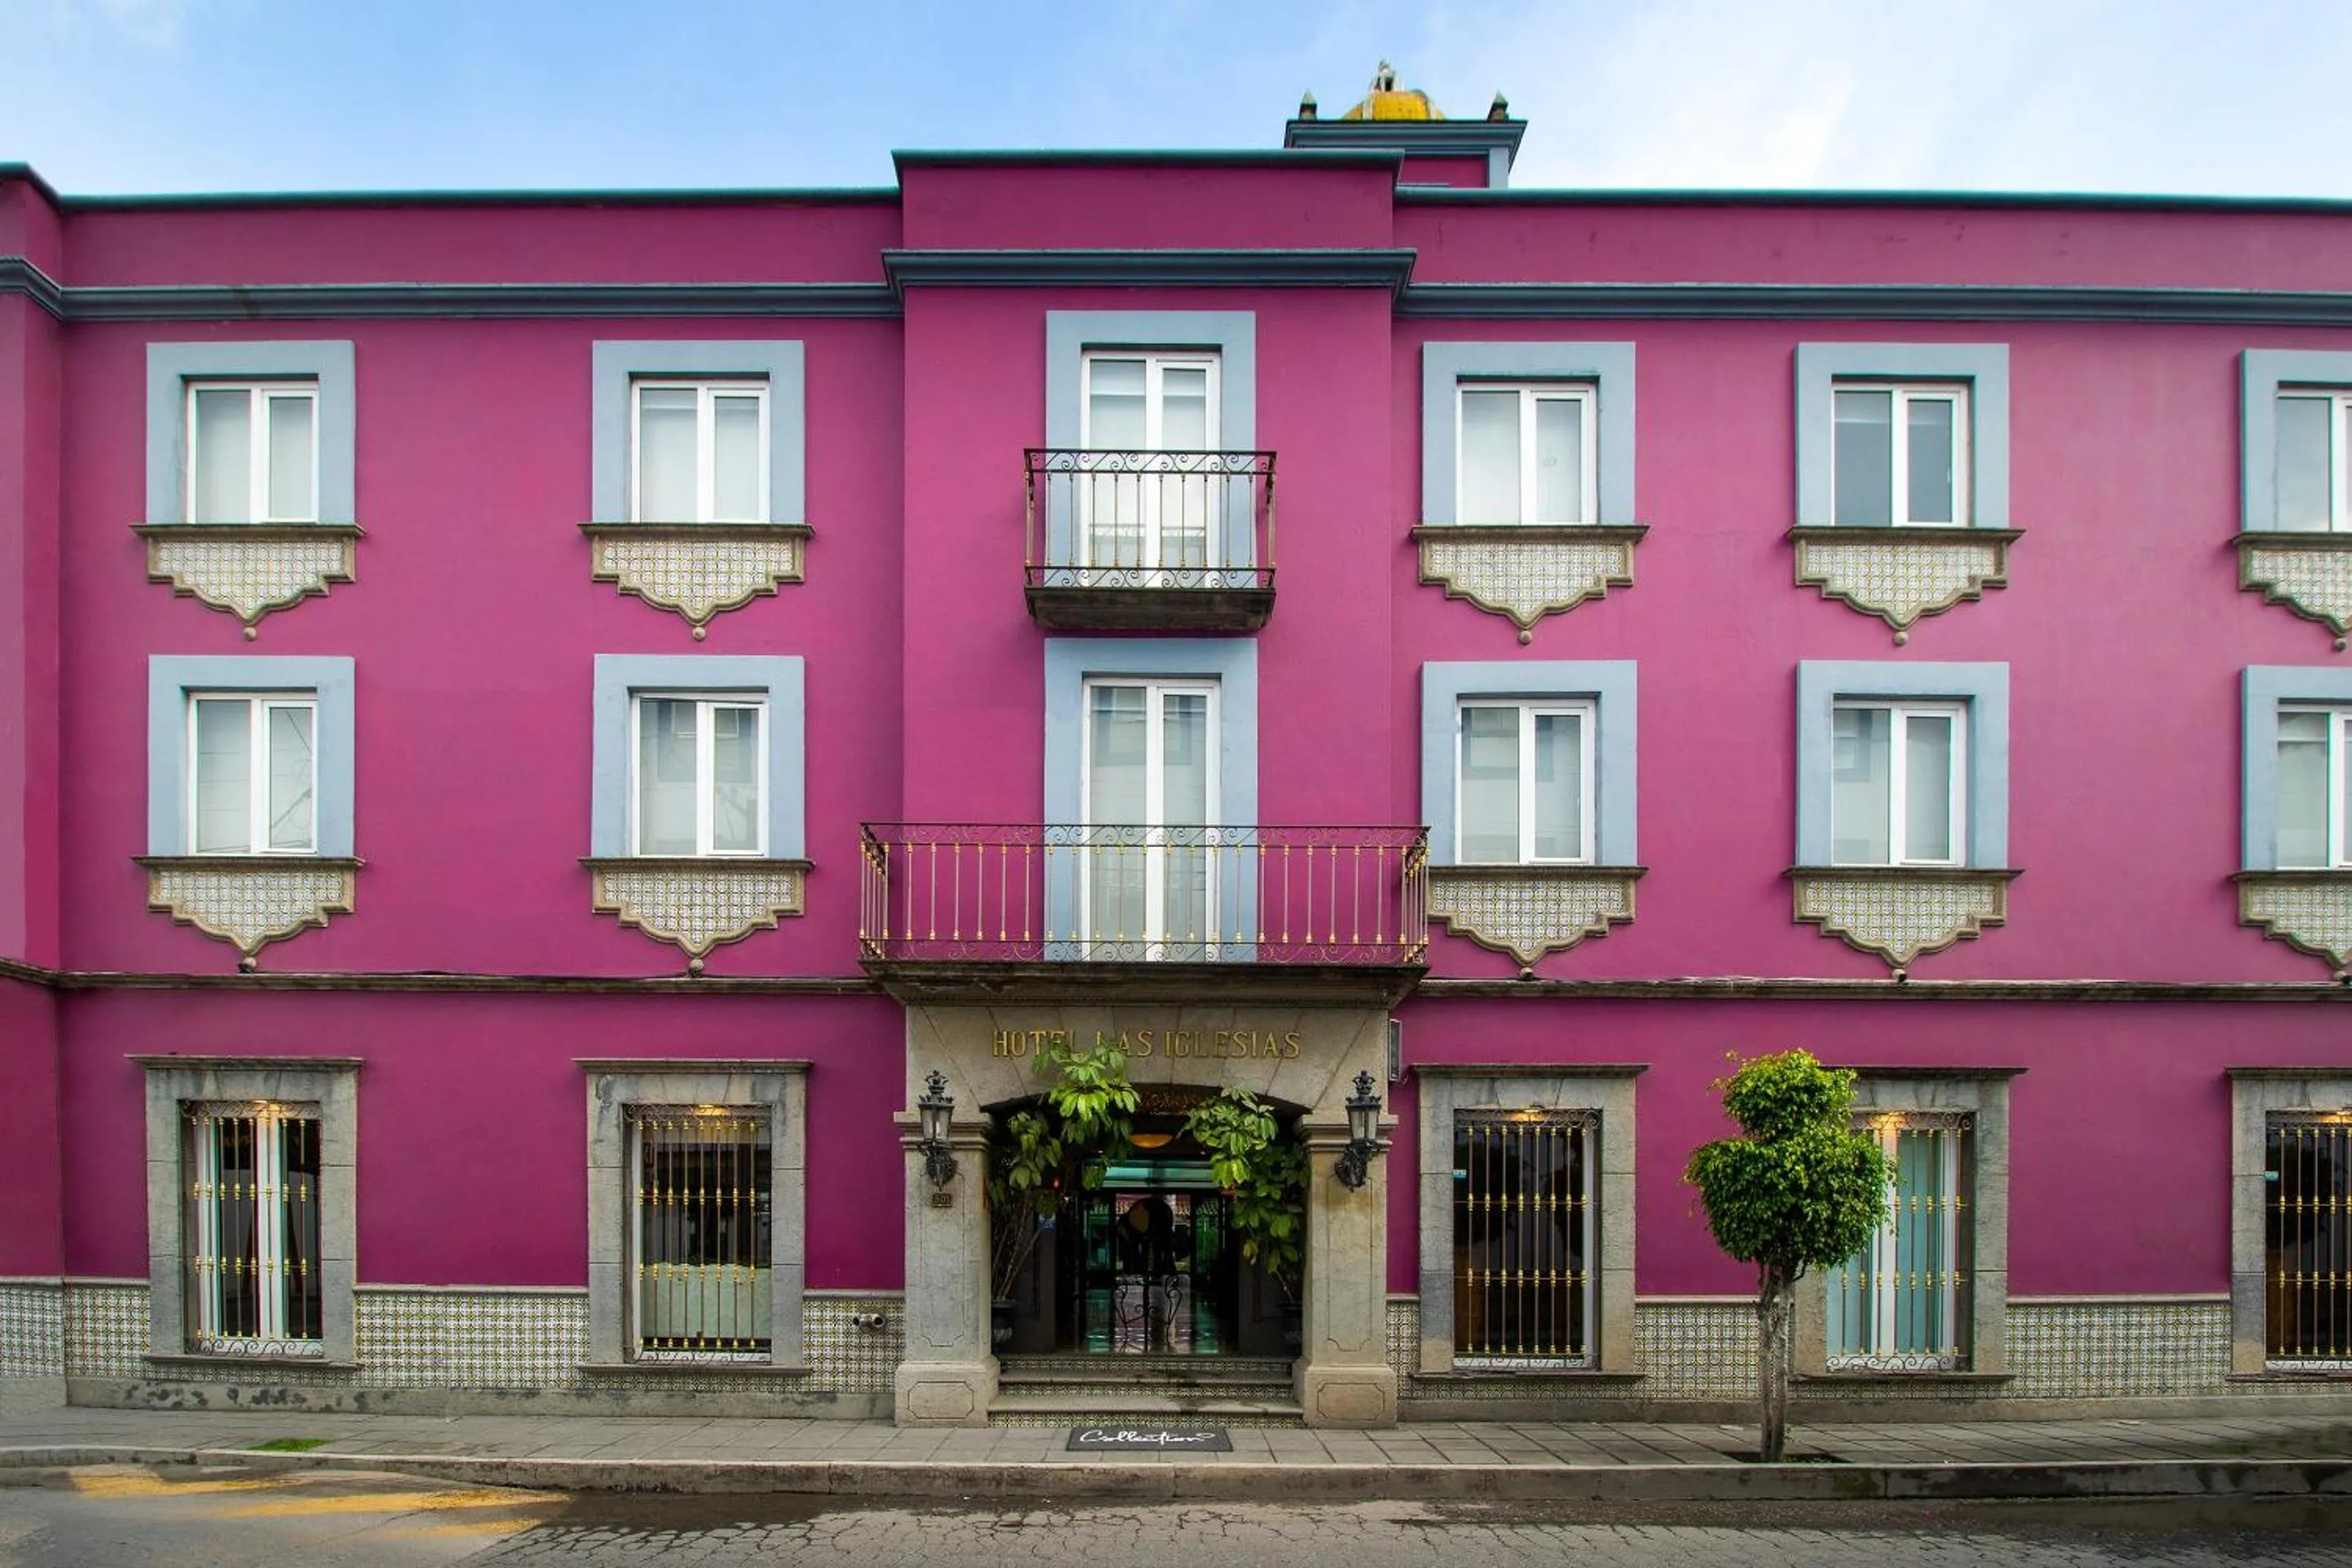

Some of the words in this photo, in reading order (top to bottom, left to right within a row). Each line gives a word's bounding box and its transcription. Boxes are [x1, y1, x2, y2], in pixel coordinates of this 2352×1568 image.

[992, 1030, 1079, 1058] HOTEL
[1165, 1031, 1301, 1058] IGLESIAS
[1080, 1429, 1216, 1446] Collection
